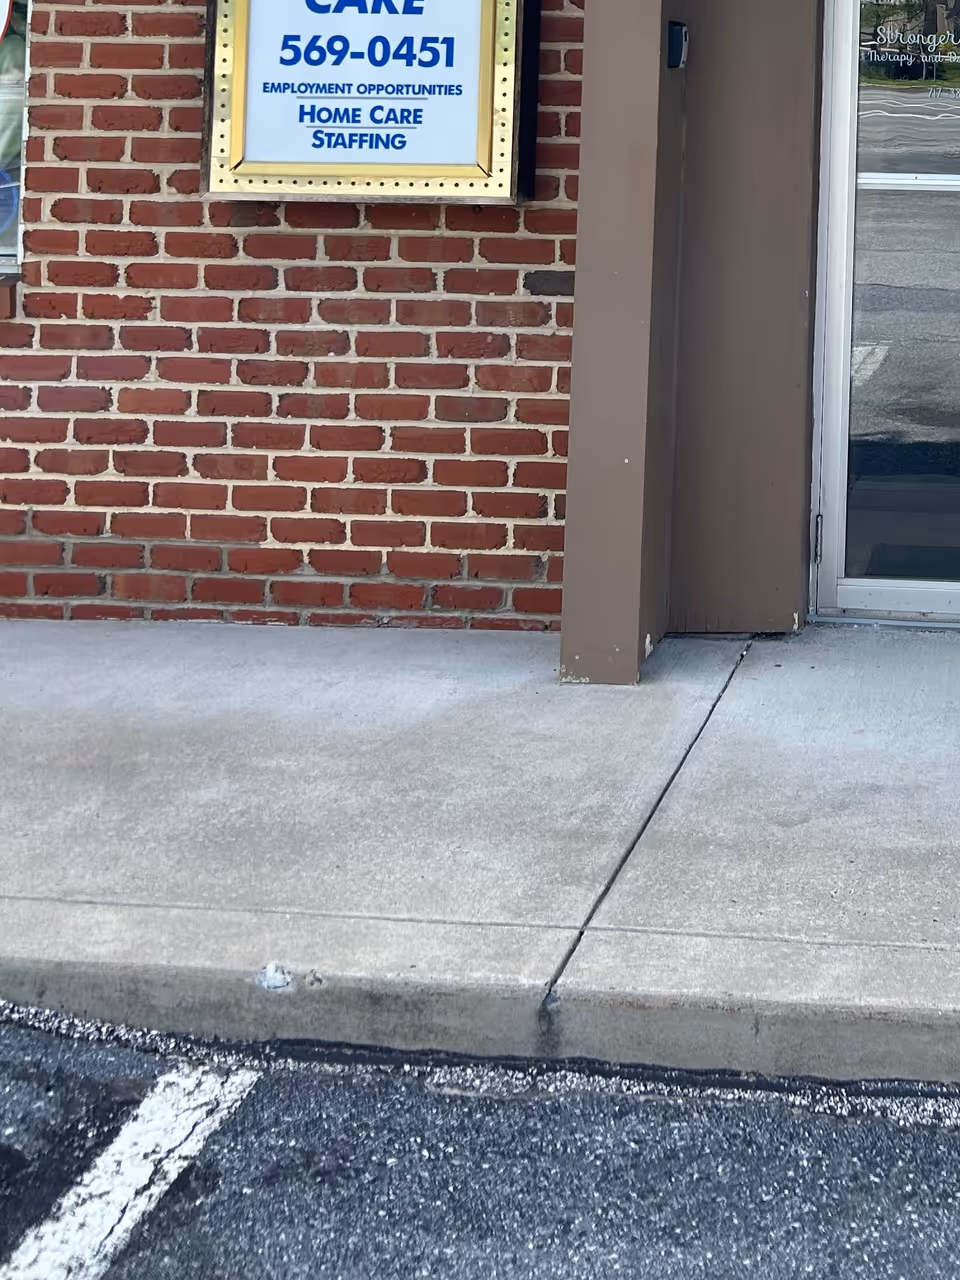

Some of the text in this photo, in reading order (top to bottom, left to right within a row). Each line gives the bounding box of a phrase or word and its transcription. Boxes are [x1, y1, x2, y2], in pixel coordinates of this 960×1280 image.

[876, 25, 960, 52] Stronger
[279, 34, 454, 68] 569-0451
[867, 50, 915, 66] Therapy
[921, 52, 945, 63] and
[262, 81, 463, 96] EMPLOYMENT OPPORTUNITIES
[299, 104, 424, 125] HOME CARE
[312, 129, 407, 150] STAFFING
